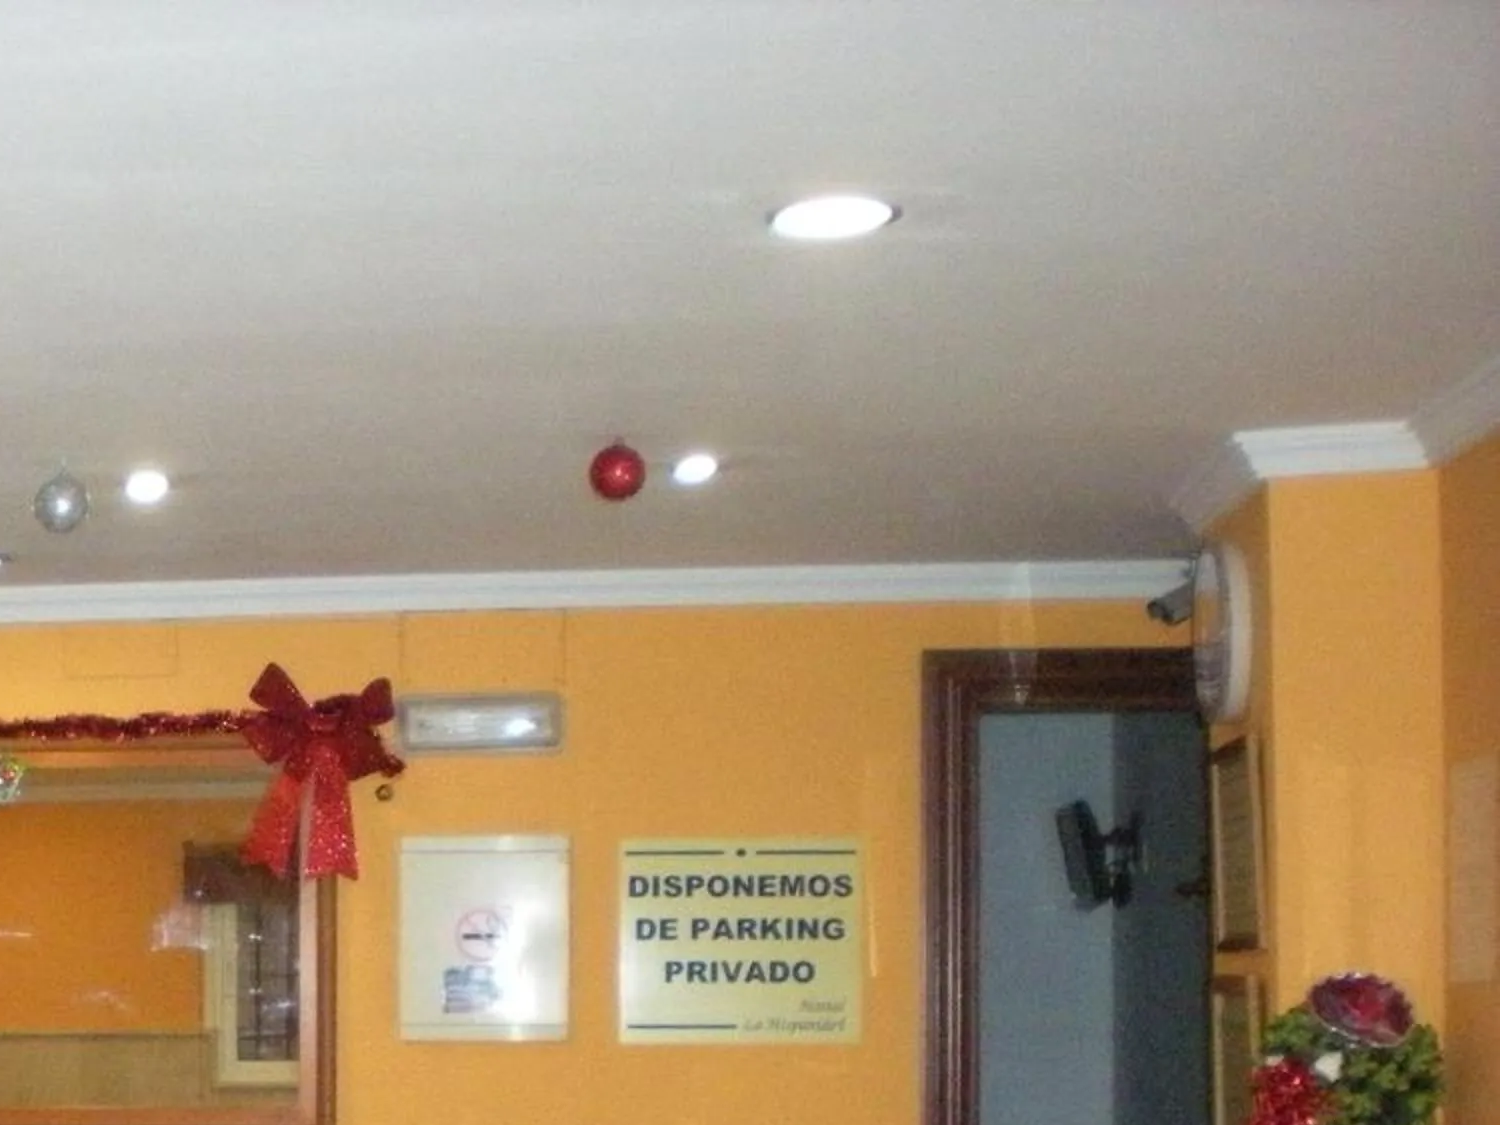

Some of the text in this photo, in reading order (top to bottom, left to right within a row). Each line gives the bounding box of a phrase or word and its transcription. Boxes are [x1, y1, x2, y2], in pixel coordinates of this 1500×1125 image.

[628, 875, 854, 898] DISPONEMOS
[635, 918, 846, 940] DE PARKING
[664, 961, 816, 983] PRIVADO
